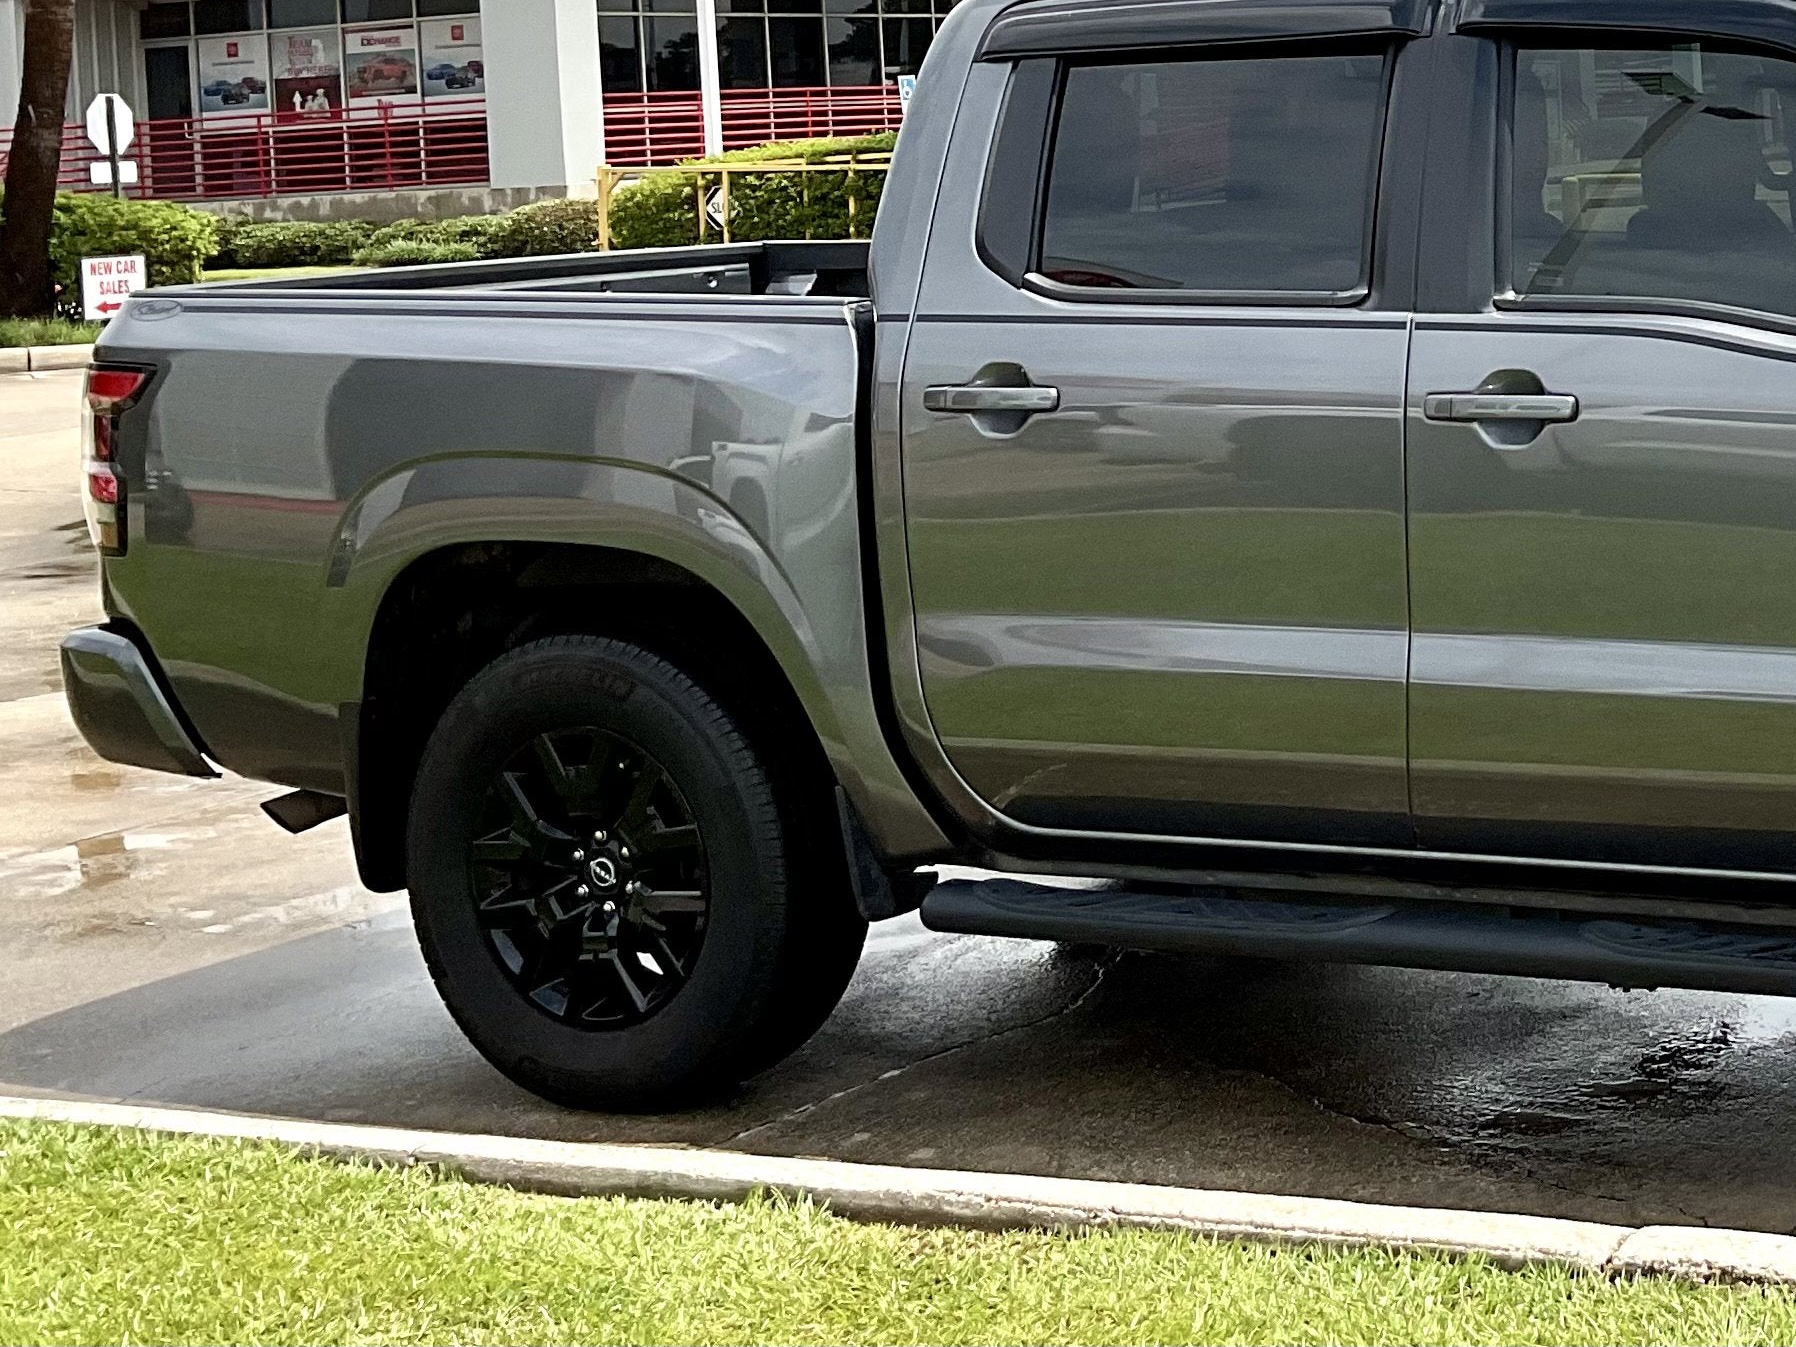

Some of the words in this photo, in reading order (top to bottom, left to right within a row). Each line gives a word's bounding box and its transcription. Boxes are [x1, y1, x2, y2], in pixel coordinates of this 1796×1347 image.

[90, 261, 112, 276] NEW
[116, 260, 137, 274] CAR
[99, 279, 130, 295] SALES
